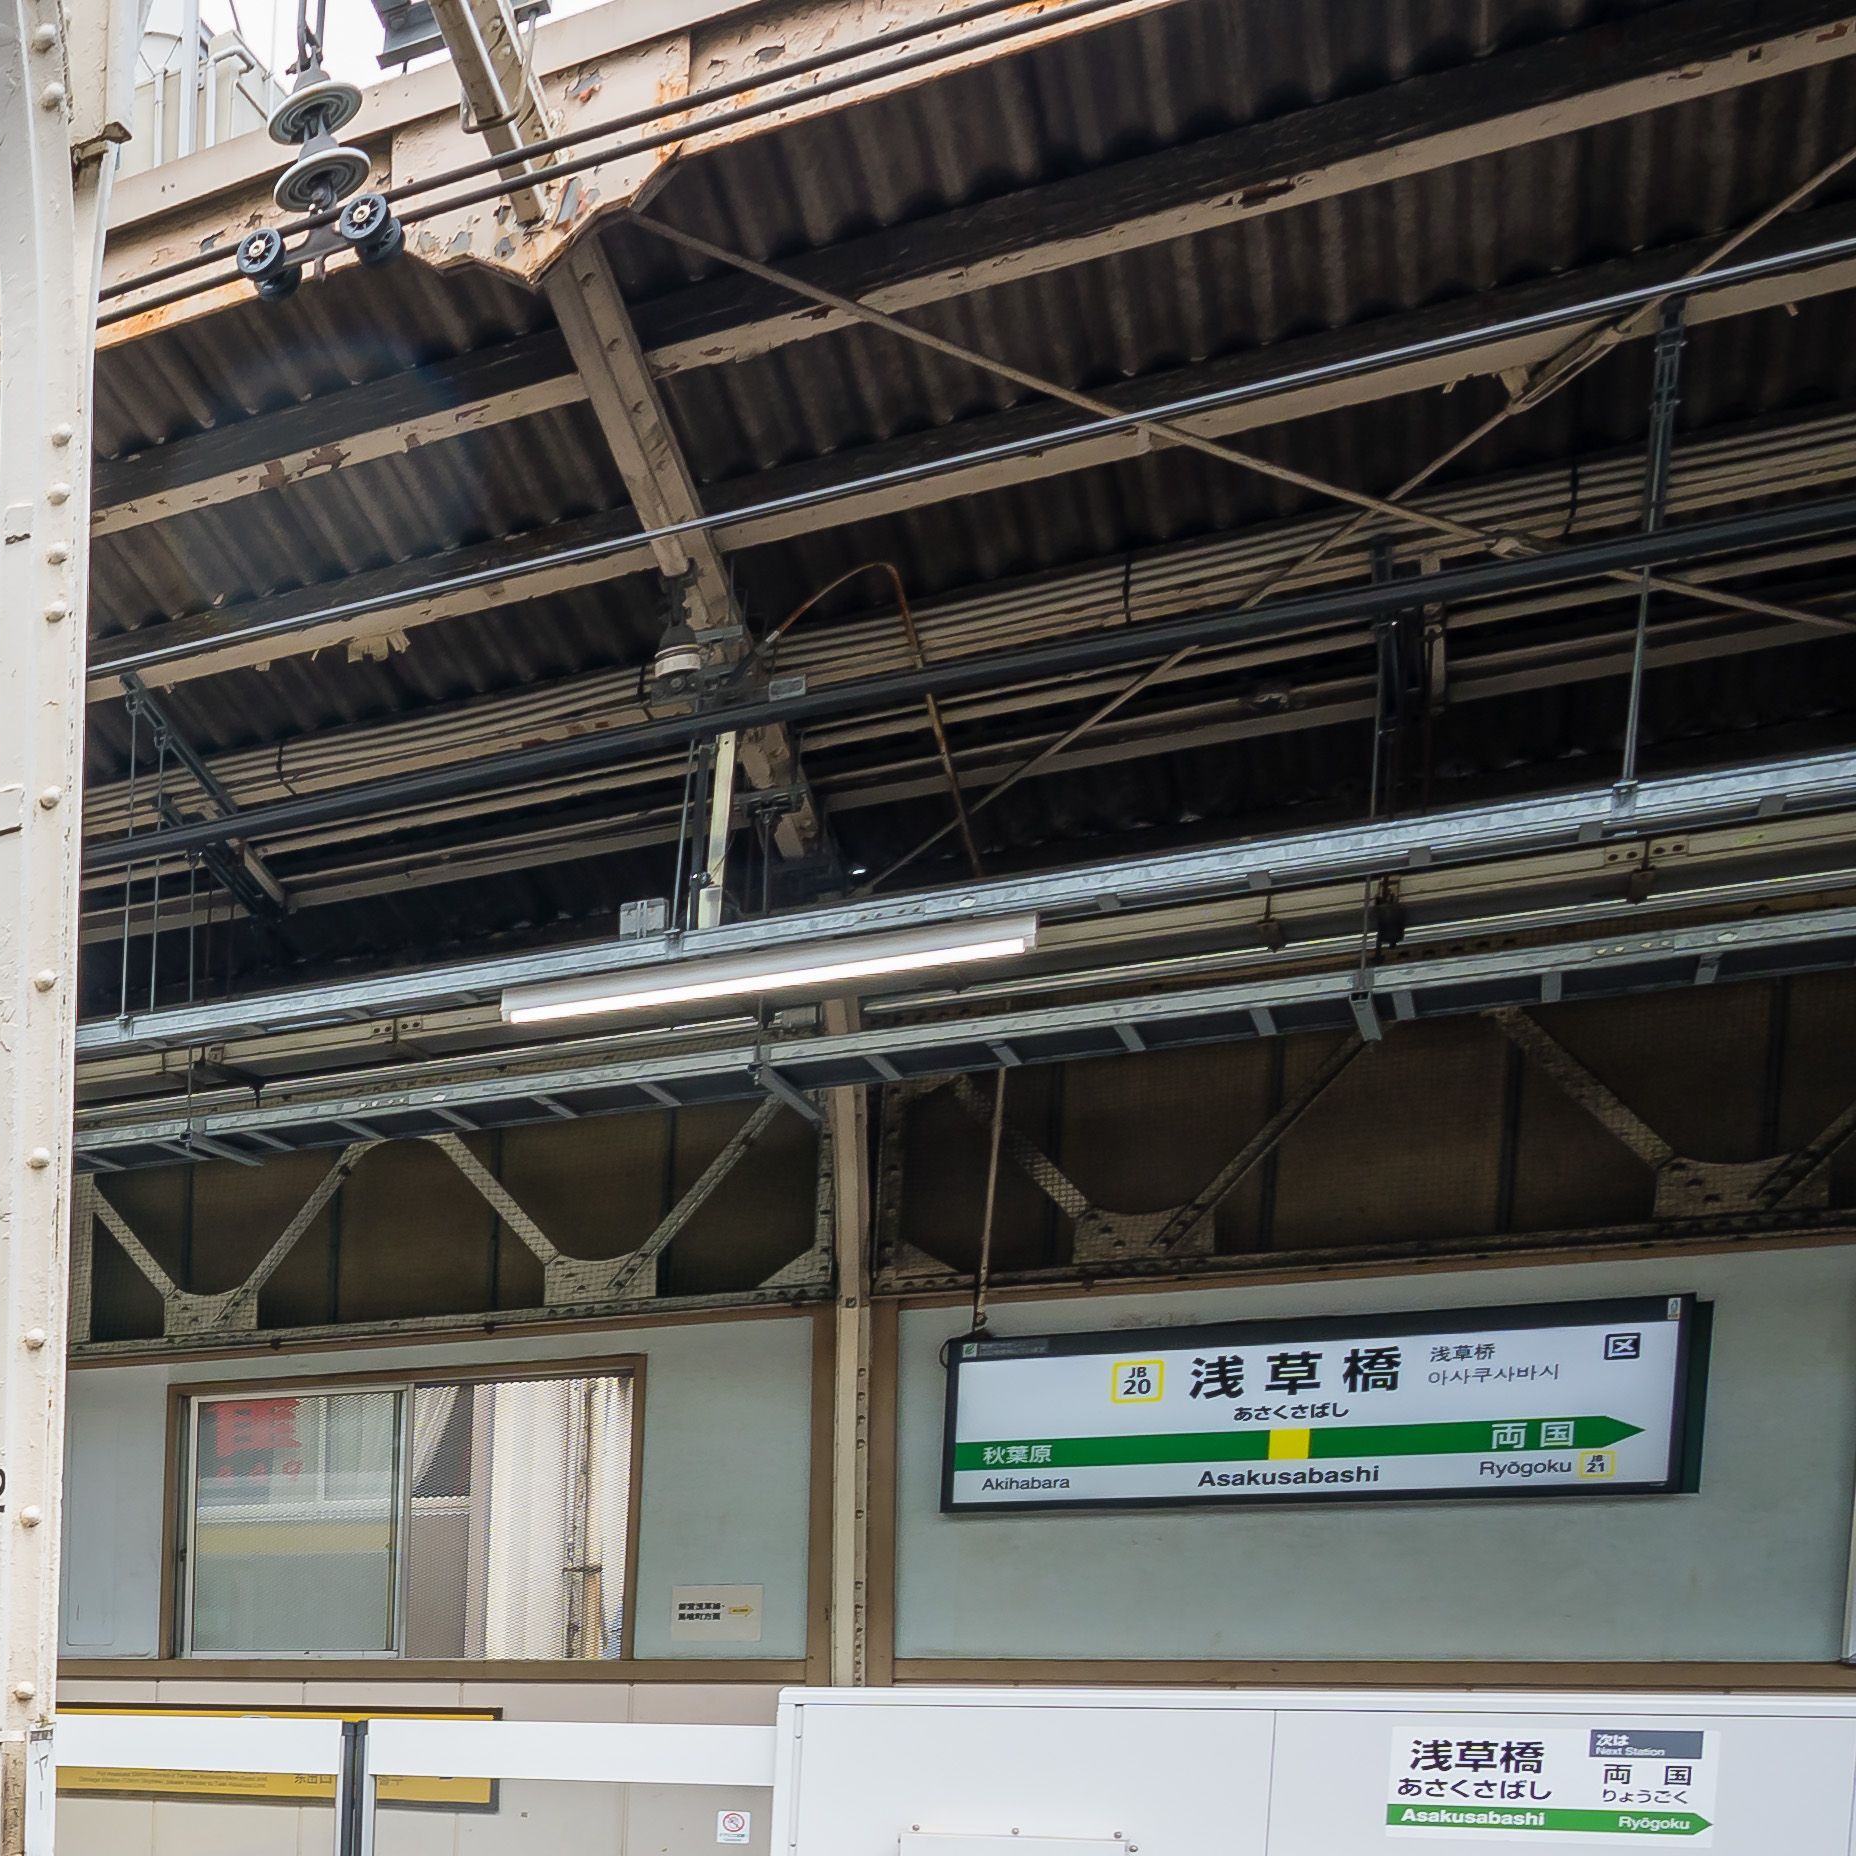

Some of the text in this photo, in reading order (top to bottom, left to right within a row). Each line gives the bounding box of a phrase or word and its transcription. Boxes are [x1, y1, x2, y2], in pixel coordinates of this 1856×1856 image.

[1128, 1366, 1147, 1379] JB
[1189, 1345, 1402, 1400] 浅草橋
[1429, 1363, 1560, 1386] 아사쿠사바시
[1123, 1379, 1152, 1396] 20
[1233, 1402, 1349, 1421] あさくさばし
[1491, 1420, 1575, 1450] 両国
[982, 1444, 1052, 1465] 秋葉原
[1197, 1465, 1379, 1488] Asakusabashi
[1479, 1459, 1572, 1478] Ryōgoku
[1587, 1462, 1606, 1473] 21
[981, 1476, 1070, 1492] Akihabara
[1595, 1733, 1629, 1747] 次は
[1409, 1739, 1545, 1774] 浅草橋
[1595, 1747, 1666, 1757] Next Station
[1603, 1763, 1692, 1787] 両国
[1397, 1777, 1552, 1801] あさくさばし
[1602, 1788, 1689, 1804] りょうごく
[1401, 1808, 1545, 1827] Asakusabashi
[1618, 1815, 1690, 1832] Ryōgoku
